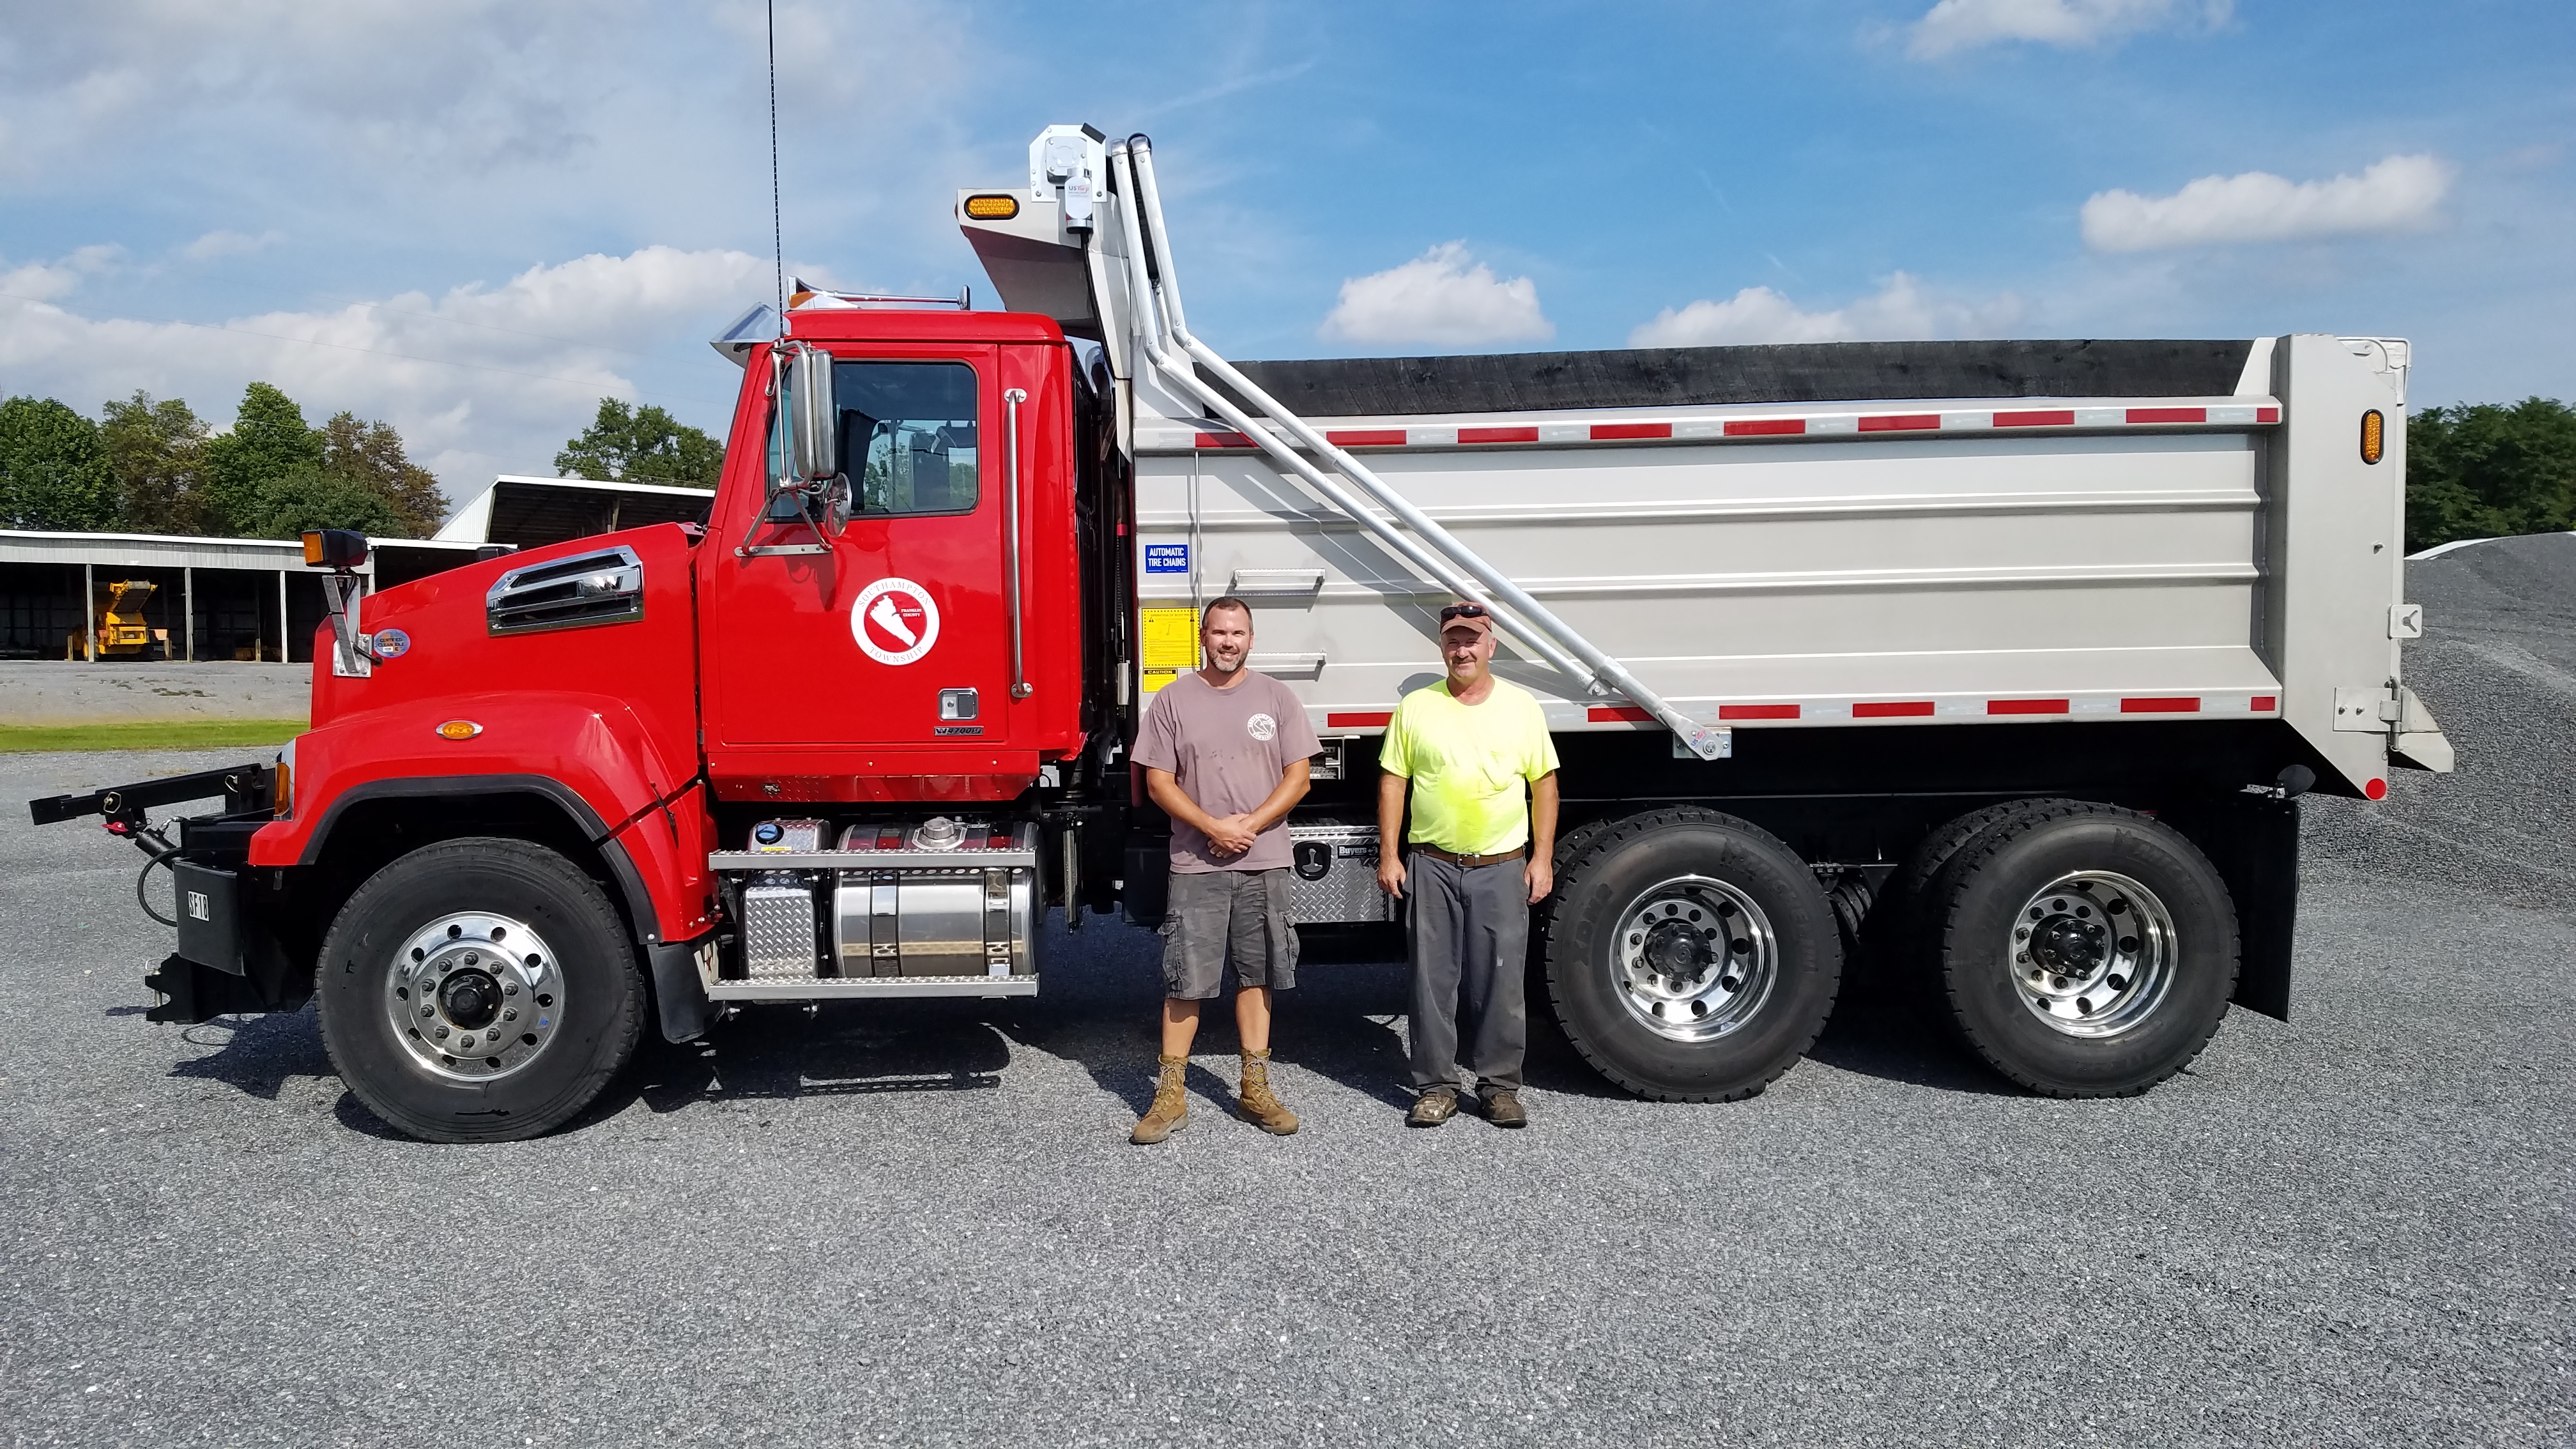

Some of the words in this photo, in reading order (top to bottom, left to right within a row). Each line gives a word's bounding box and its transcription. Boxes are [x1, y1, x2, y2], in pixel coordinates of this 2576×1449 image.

[1149, 548, 1184, 556] AUTOMATIC
[1147, 558, 1162, 567] TIRE
[1163, 558, 1186, 567] CHAINS
[859, 581, 931, 607] SOUTHAMPTON
[870, 646, 923, 663] TOWNSHIP
[1338, 846, 1367, 855] Buyers
[189, 893, 208, 919] SF18
